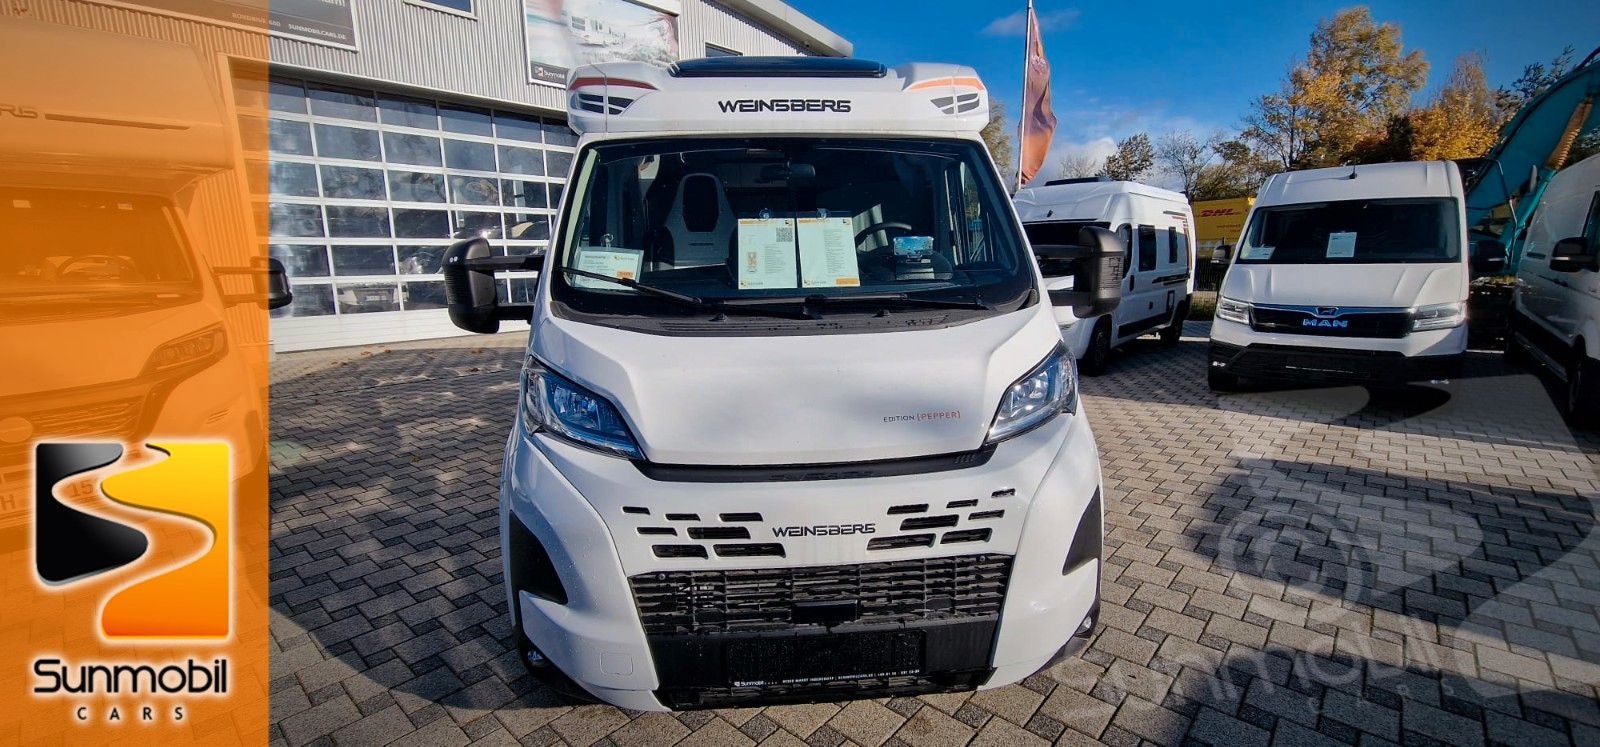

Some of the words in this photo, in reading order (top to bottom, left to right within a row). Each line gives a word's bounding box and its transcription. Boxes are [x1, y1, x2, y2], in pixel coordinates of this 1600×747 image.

[718, 99, 851, 113] WEINSBERG
[1201, 208, 1234, 217] DHL
[1303, 318, 1348, 328] MAN
[883, 415, 915, 423] EDITION
[772, 523, 876, 538] WEINSBERG
